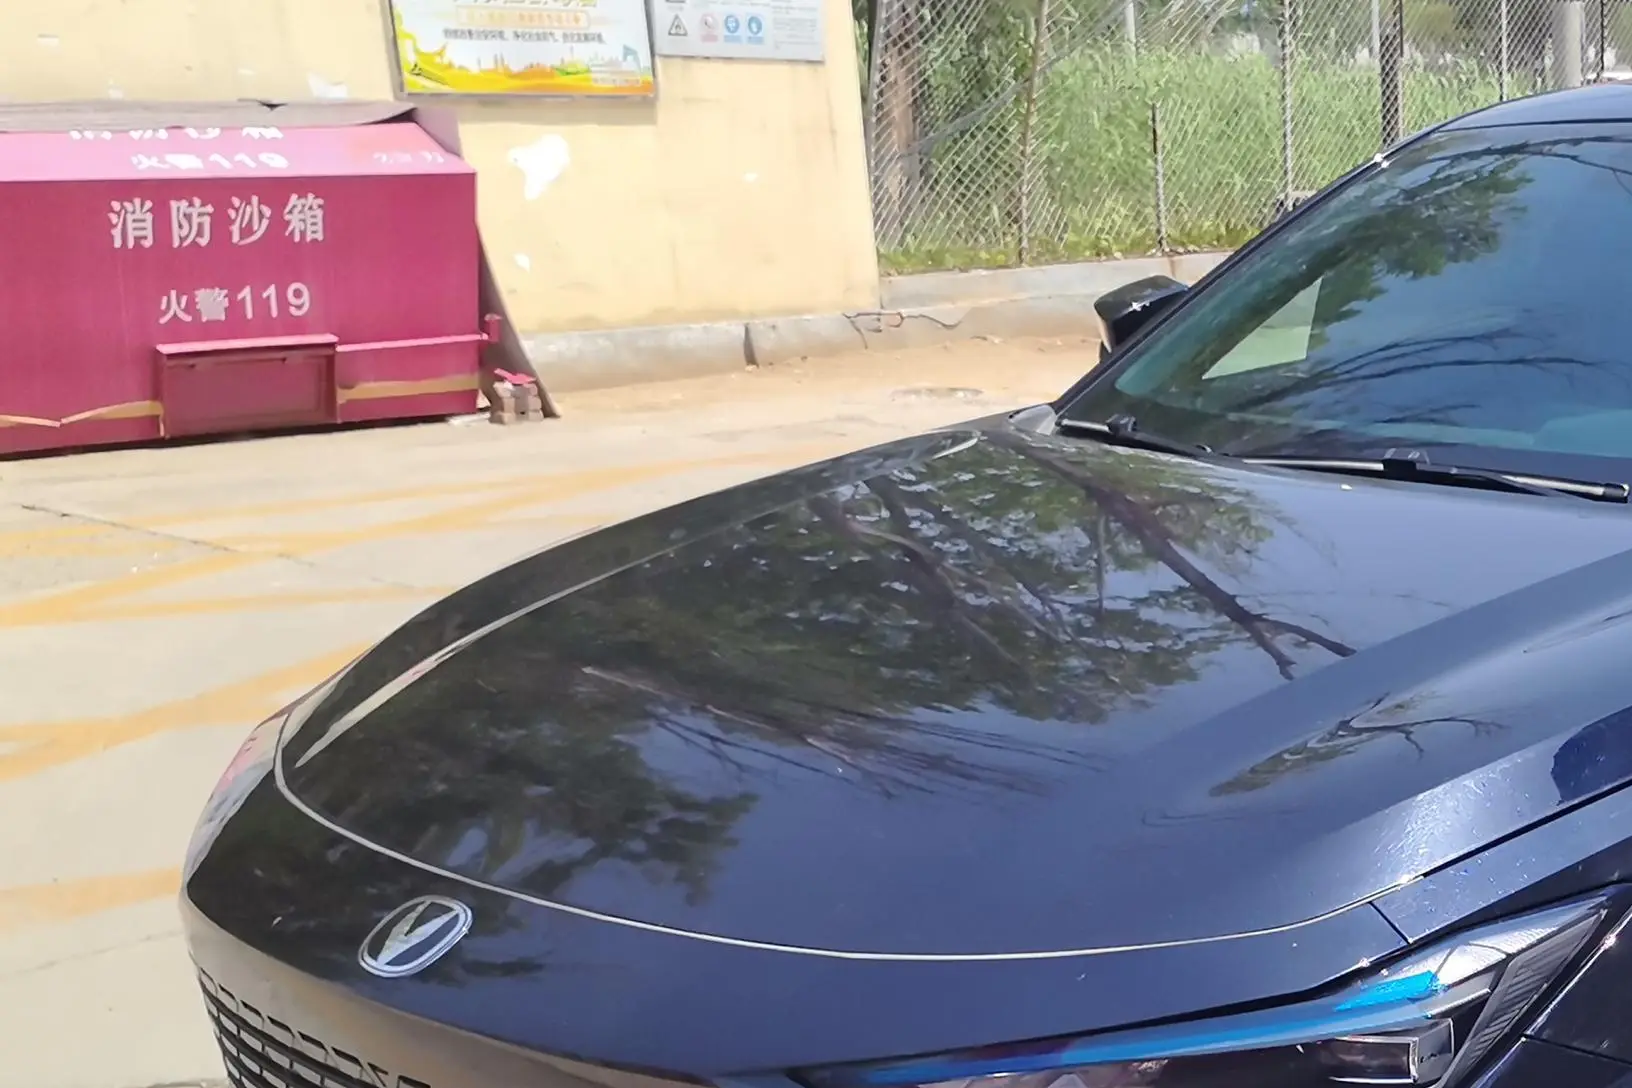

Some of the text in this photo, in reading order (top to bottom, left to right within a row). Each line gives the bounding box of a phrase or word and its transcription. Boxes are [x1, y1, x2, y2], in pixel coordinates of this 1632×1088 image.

[107, 192, 325, 250] 消防沙箱
[157, 280, 311, 325] 火警119
